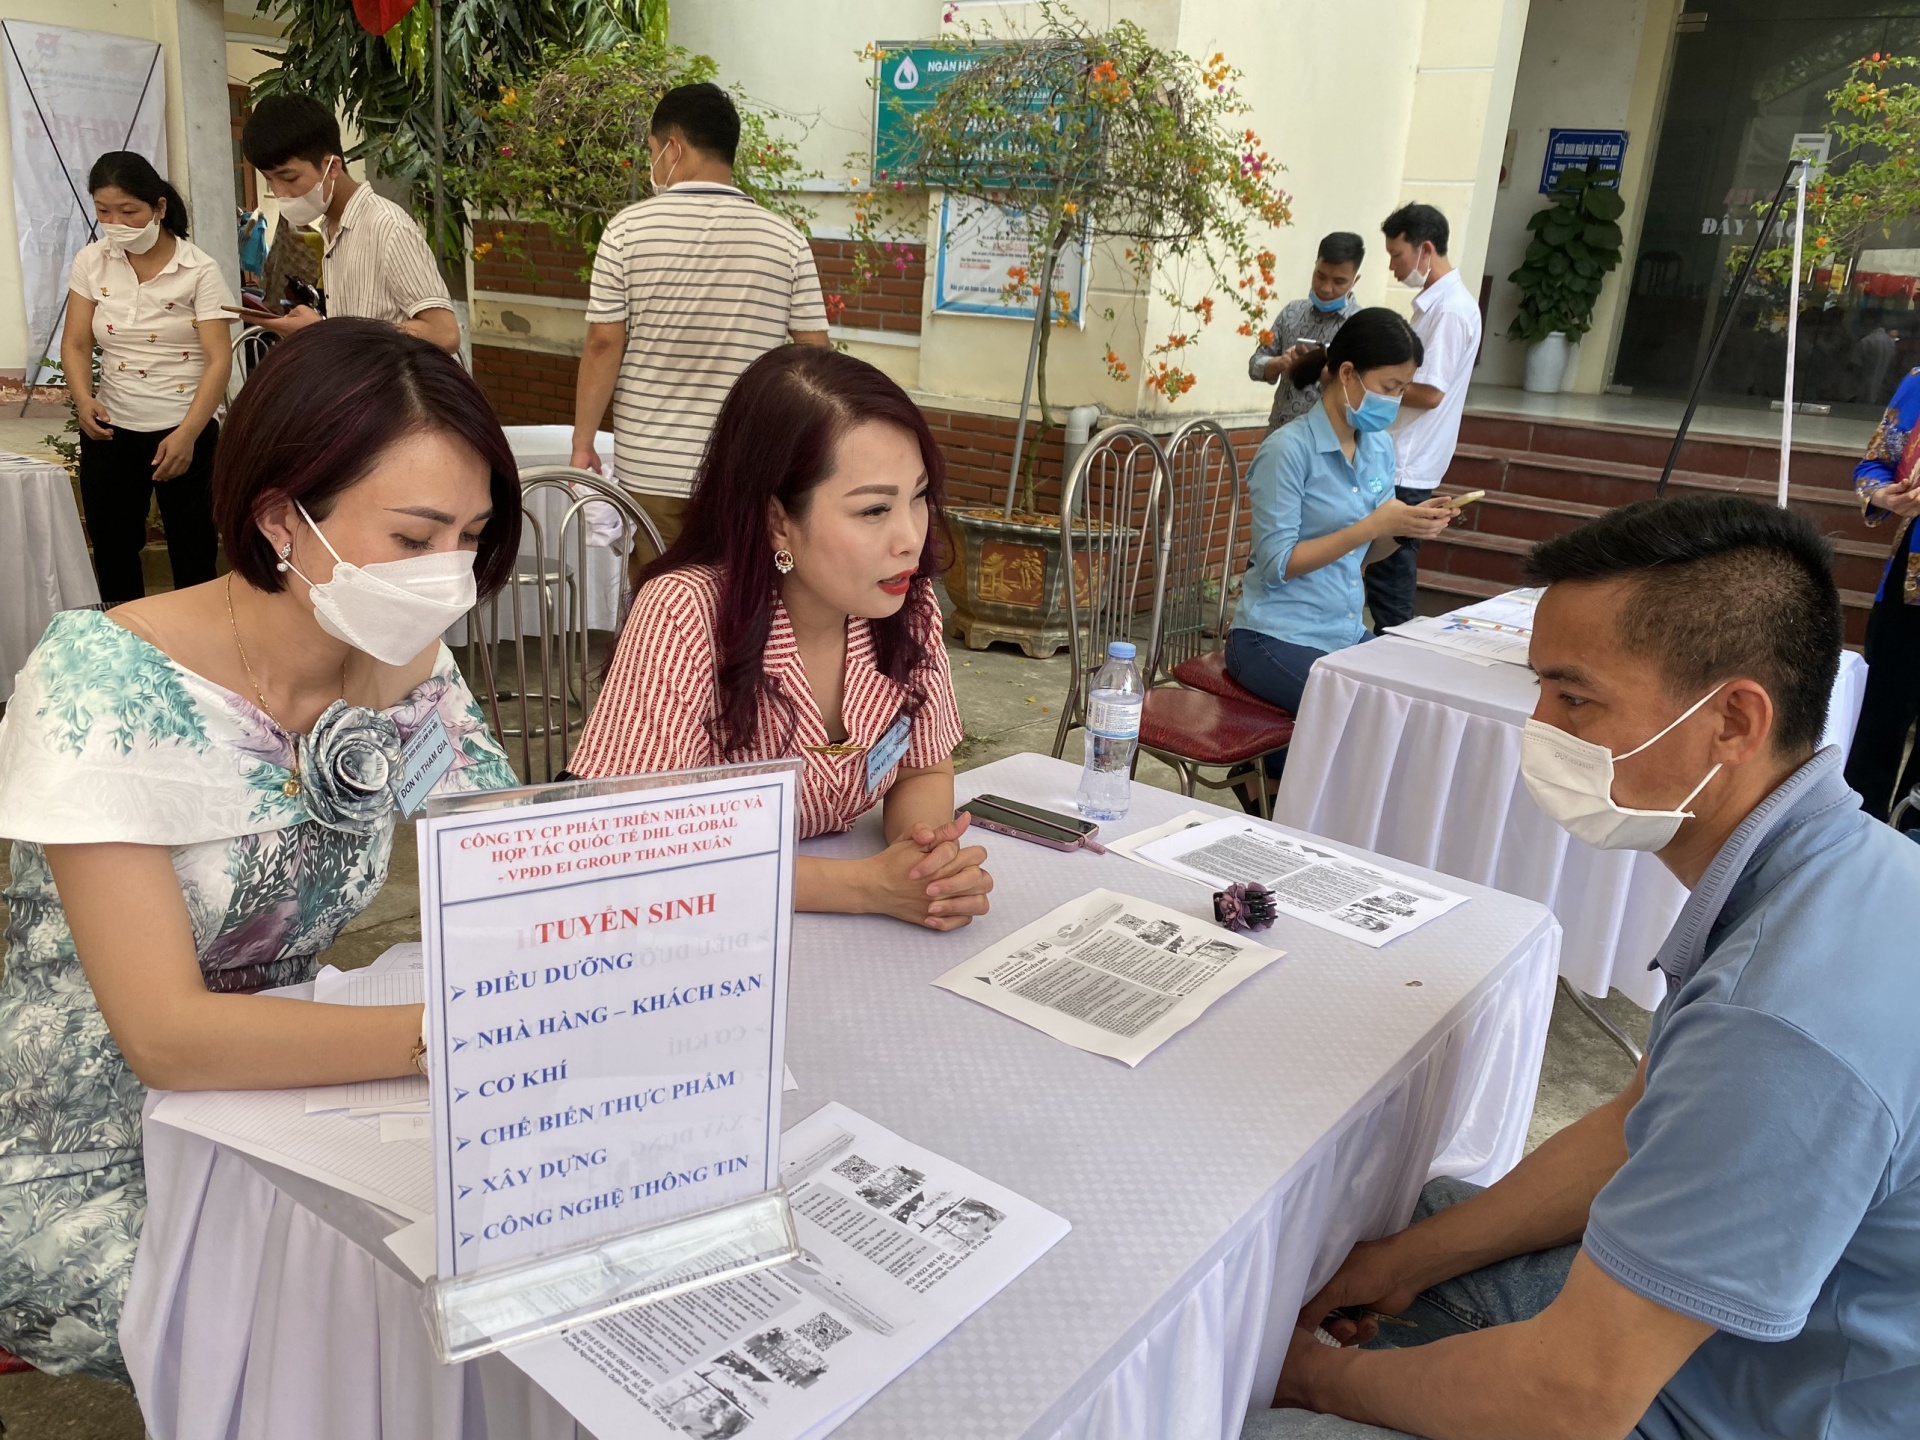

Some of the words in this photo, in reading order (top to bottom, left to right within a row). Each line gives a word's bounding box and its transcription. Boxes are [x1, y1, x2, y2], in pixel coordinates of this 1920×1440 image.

[401, 781, 416, 799] ĐƠN
[421, 751, 438, 773] THAM
[438, 739, 448, 754] GIA
[459, 831, 512, 850] CÔNG
[515, 829, 536, 844] TY
[540, 824, 563, 839] CP
[566, 816, 608, 836] PHÁT
[664, 803, 708, 822] NHÂN
[709, 799, 740, 817] LỰC
[744, 795, 764, 810] VÀ
[490, 846, 528, 864] HỢP
[532, 840, 565, 859] TÁC
[567, 832, 614, 853] QUỐC
[619, 828, 639, 846] TẾ
[642, 825, 674, 842] DHL
[677, 816, 738, 837] GLOBAL
[507, 863, 554, 881] VPĐD
[556, 860, 573, 875] EI
[575, 850, 632, 871] GROUP
[636, 842, 690, 862] THANH
[691, 835, 733, 854] XUÂN
[534, 904, 640, 945] TUYỂN
[648, 892, 717, 925] SINH
[476, 969, 537, 998] ĐIỀU
[544, 952, 634, 984] DƯỠNG
[478, 1019, 531, 1048] NHÀ
[539, 1006, 609, 1036] HÀNG
[633, 983, 714, 1016] KHÁCH
[720, 974, 763, 997] SẠN
[478, 1074, 516, 1097] CƠ
[522, 1060, 568, 1090] KHÍ
[479, 1118, 532, 1147] CHẾ
[539, 1104, 595, 1133] BIẾN
[601, 1088, 667, 1117] THỰC
[672, 1069, 736, 1100] PHẨM
[482, 1167, 533, 1194] XÂY
[539, 1148, 608, 1181] DỰNG
[483, 1209, 554, 1241] CÔNG
[559, 1188, 625, 1221] NGHỆ
[630, 1166, 708, 1201] THÔNG
[714, 1154, 750, 1178] TIN
